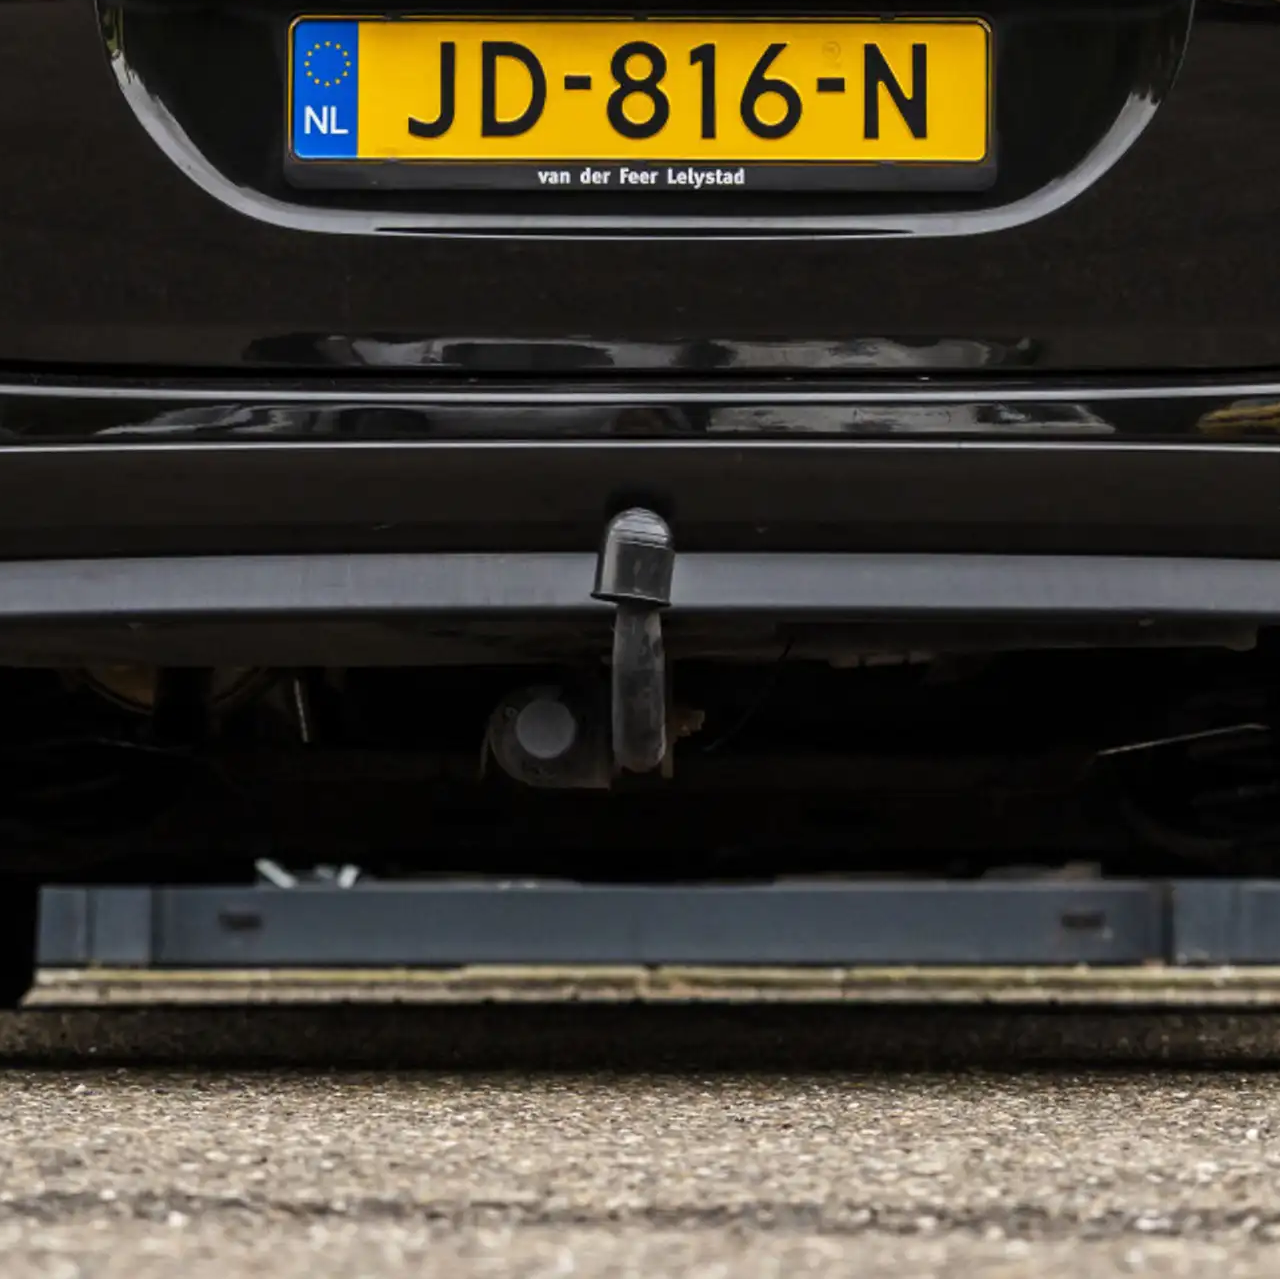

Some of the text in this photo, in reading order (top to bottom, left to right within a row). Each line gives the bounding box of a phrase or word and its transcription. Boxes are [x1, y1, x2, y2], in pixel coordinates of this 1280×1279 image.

[407, 40, 929, 141] JD-816-N
[304, 105, 349, 135] NL
[538, 167, 745, 189] van der Feer Lelystad
